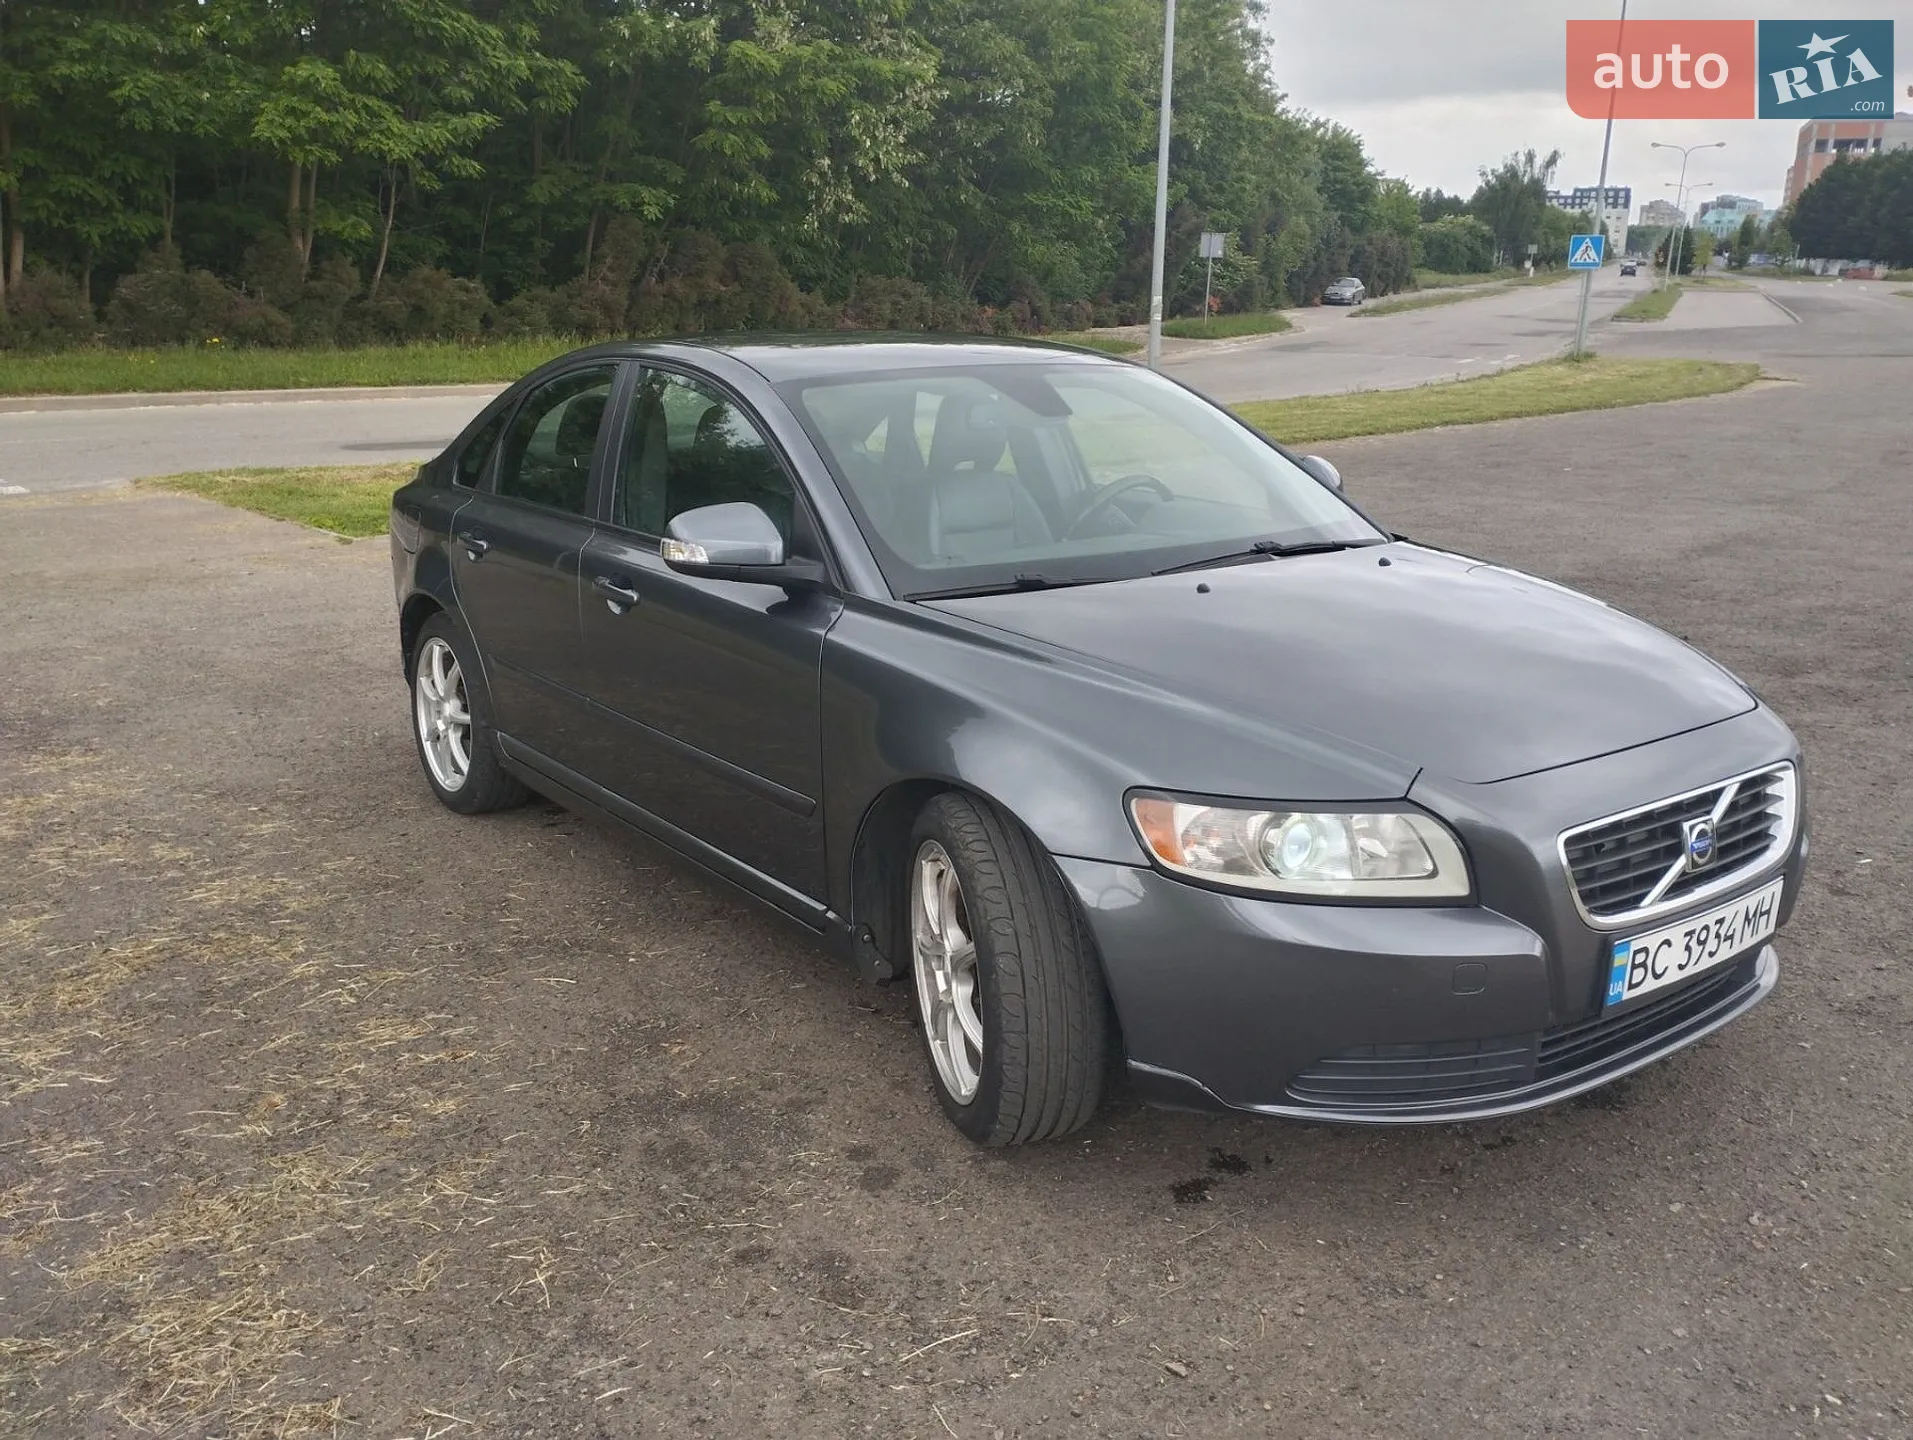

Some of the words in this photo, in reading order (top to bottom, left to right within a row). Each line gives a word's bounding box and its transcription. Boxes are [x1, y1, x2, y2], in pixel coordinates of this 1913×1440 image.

[1627, 938, 1672, 991] BC
[1677, 910, 1739, 971] 3934
[1740, 891, 1776, 944] MH
[1609, 981, 1623, 996] UA
